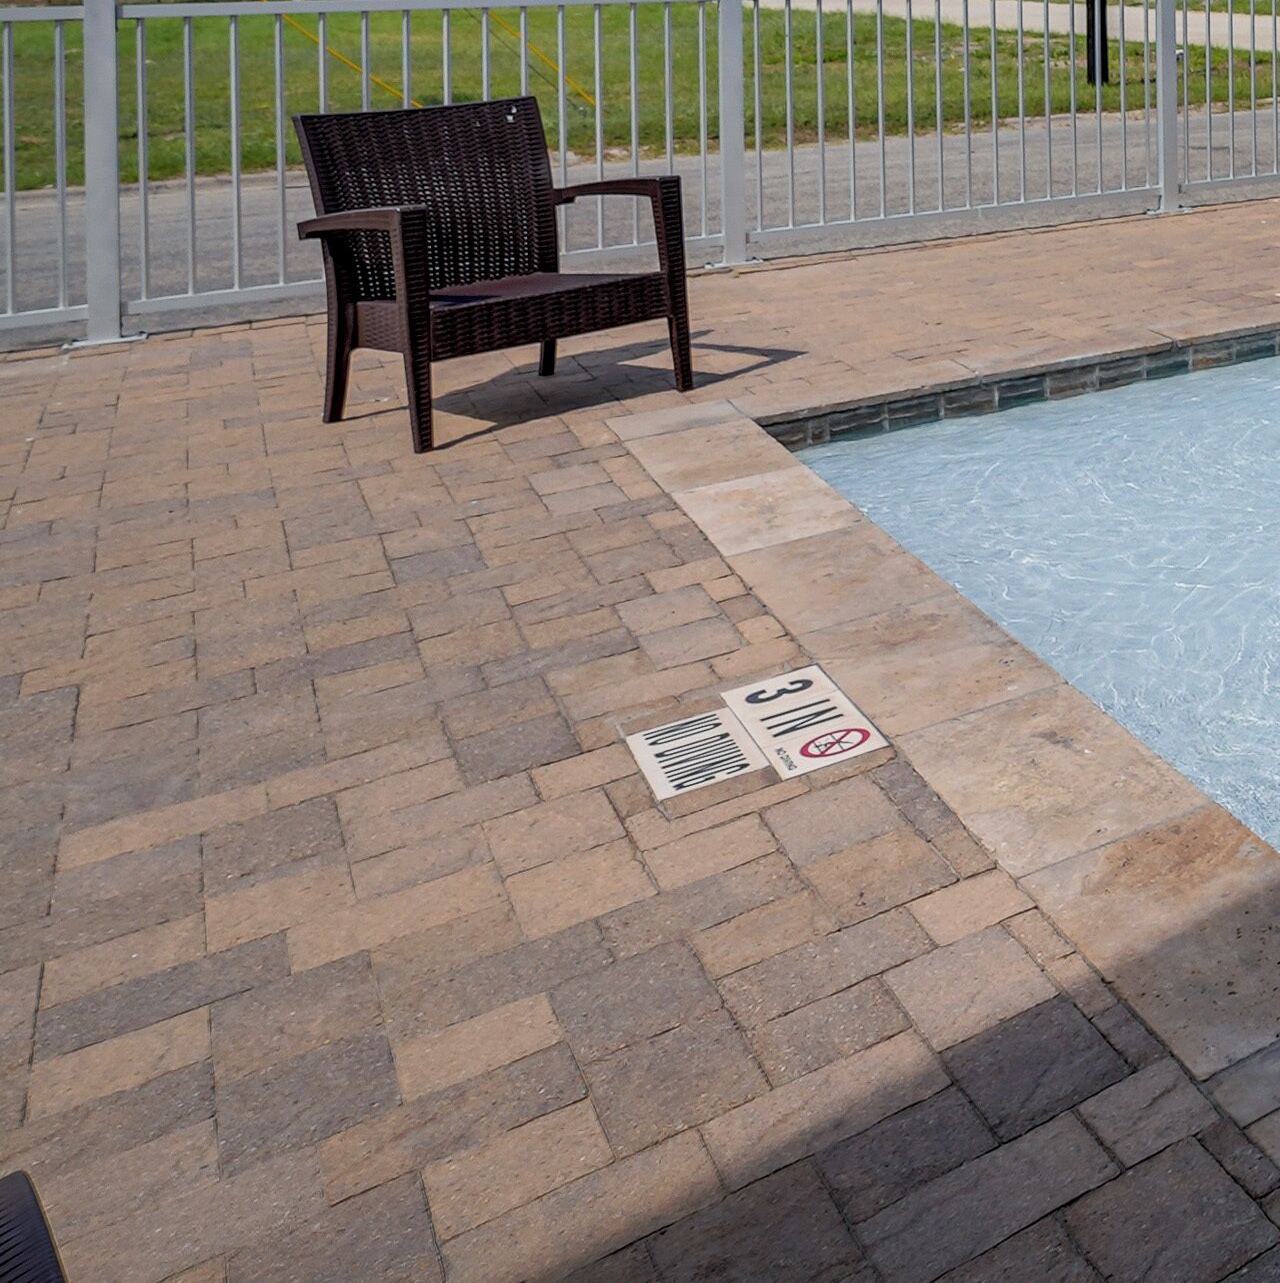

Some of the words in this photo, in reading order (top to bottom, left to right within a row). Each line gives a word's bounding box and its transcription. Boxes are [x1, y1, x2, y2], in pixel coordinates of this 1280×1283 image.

[745, 679, 813, 704] 3
[642, 713, 722, 746] NO
[760, 698, 844, 738] IN
[654, 732, 750, 791] DIVING
